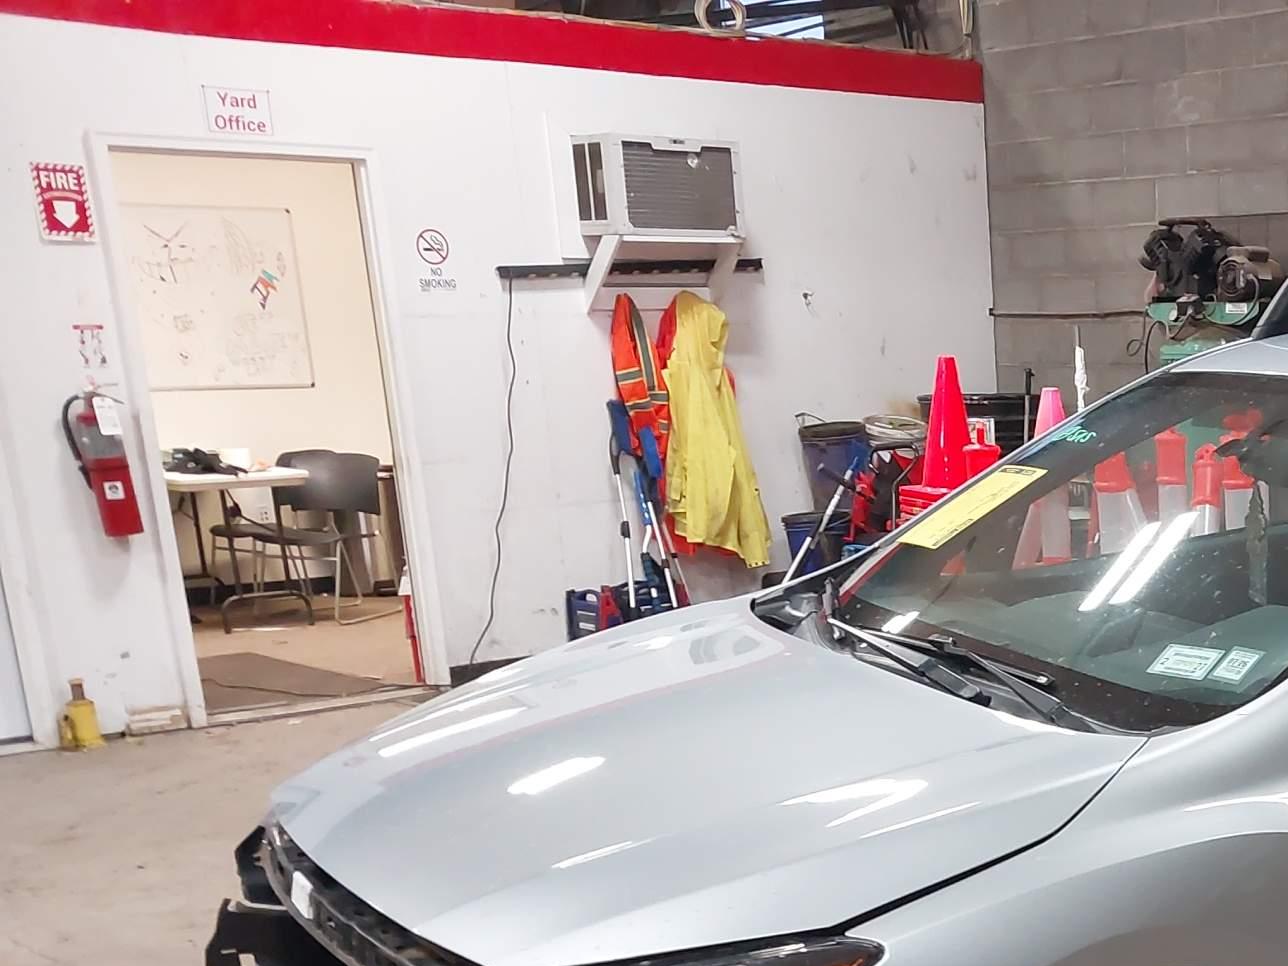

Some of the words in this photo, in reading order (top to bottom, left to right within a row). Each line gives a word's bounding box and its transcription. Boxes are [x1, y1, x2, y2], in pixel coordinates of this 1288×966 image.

[216, 91, 257, 109] Yard
[214, 114, 267, 133] Office
[38, 170, 80, 191] FIRE
[430, 266, 442, 277] NO
[418, 278, 457, 289] SMOKING
